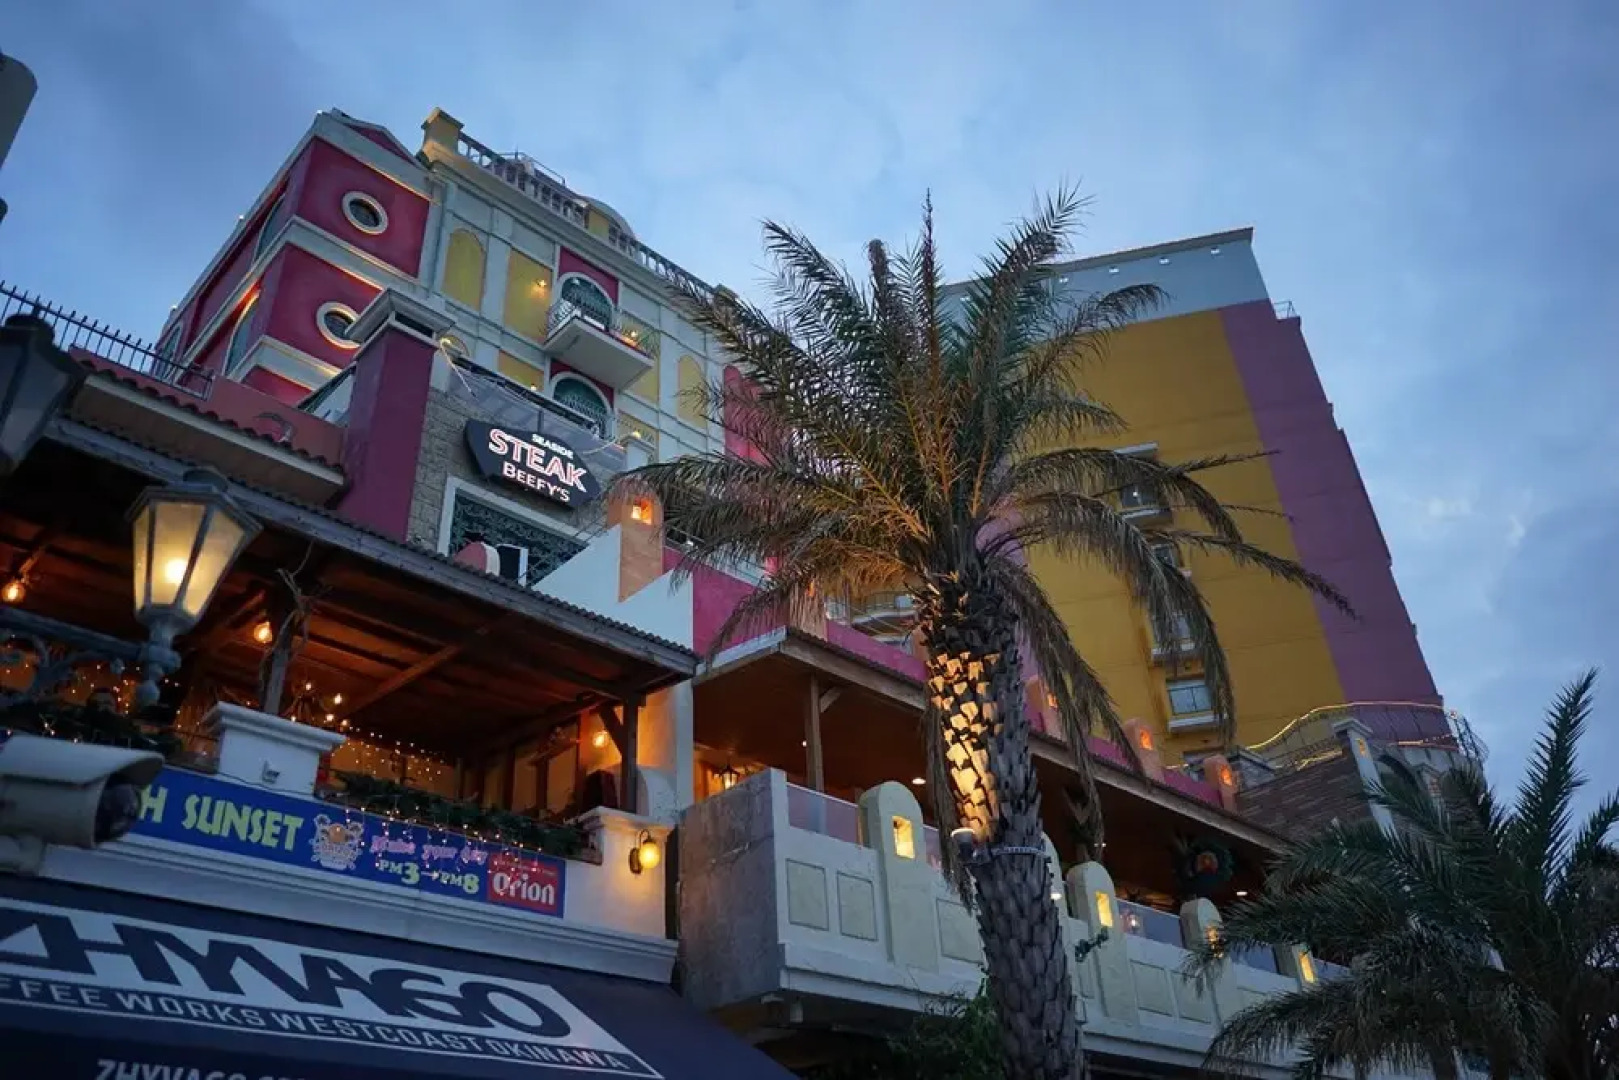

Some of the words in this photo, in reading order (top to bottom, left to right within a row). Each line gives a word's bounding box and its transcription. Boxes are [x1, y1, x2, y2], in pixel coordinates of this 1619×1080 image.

[488, 428, 587, 493] STEAK
[502, 461, 570, 502] BEEFY'S
[181, 793, 305, 851] SUNSET
[491, 871, 556, 906] Orion
[115, 991, 266, 1027] WORKS
[271, 1011, 484, 1052] WESTCOAST
[489, 1041, 631, 1071] OKINAWA
